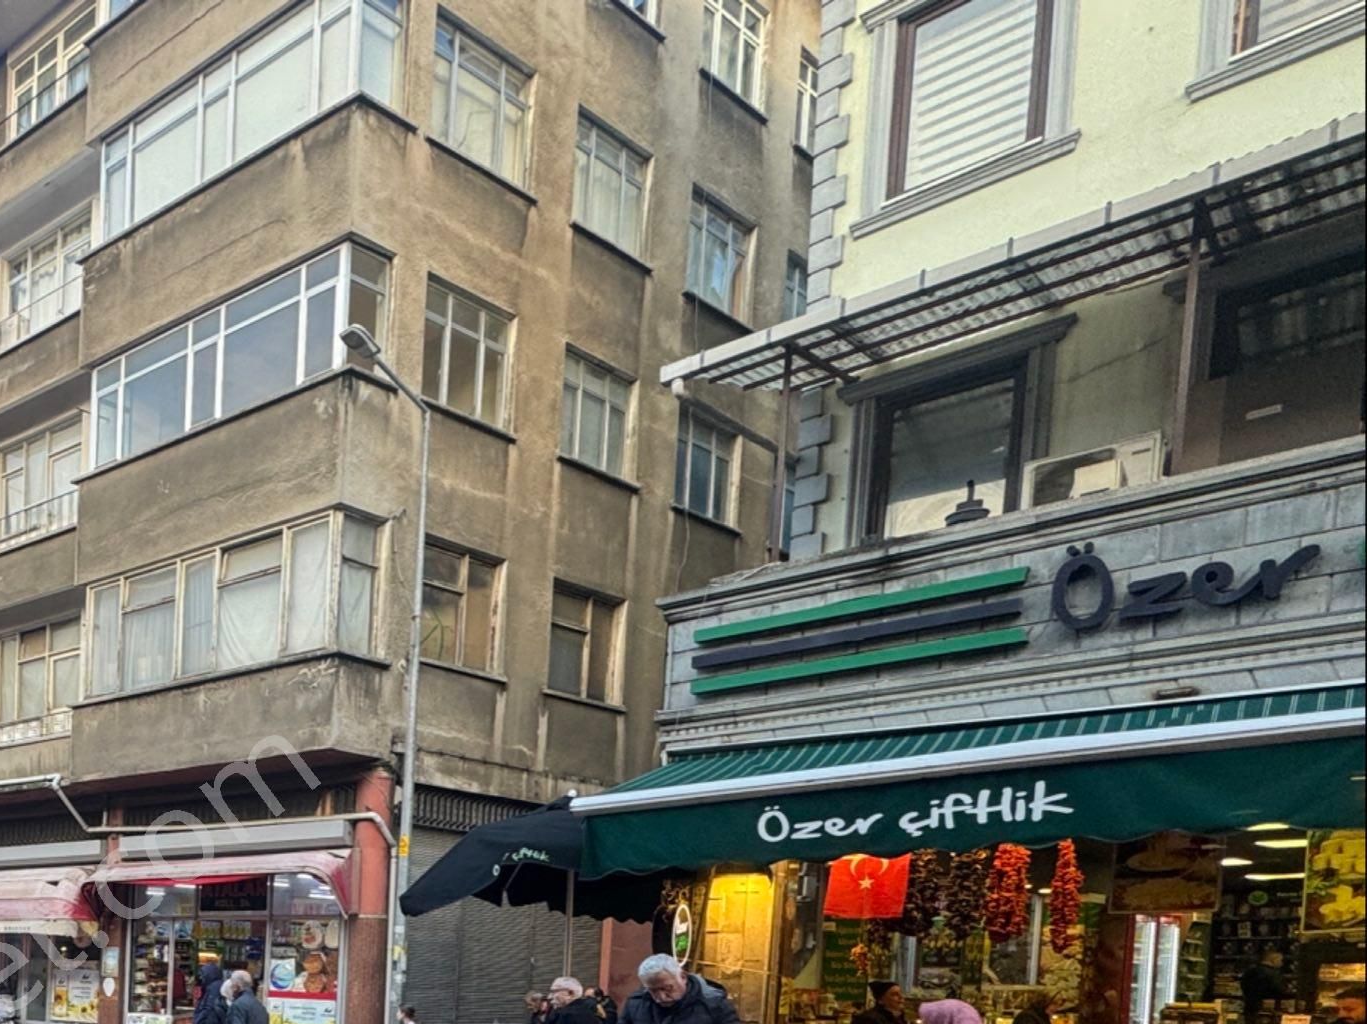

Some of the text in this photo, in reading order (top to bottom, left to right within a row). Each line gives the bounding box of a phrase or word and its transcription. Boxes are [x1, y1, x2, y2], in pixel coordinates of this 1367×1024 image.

[1052, 541, 1321, 630] Özer
[757, 780, 1074, 842] Özer çiftlik
